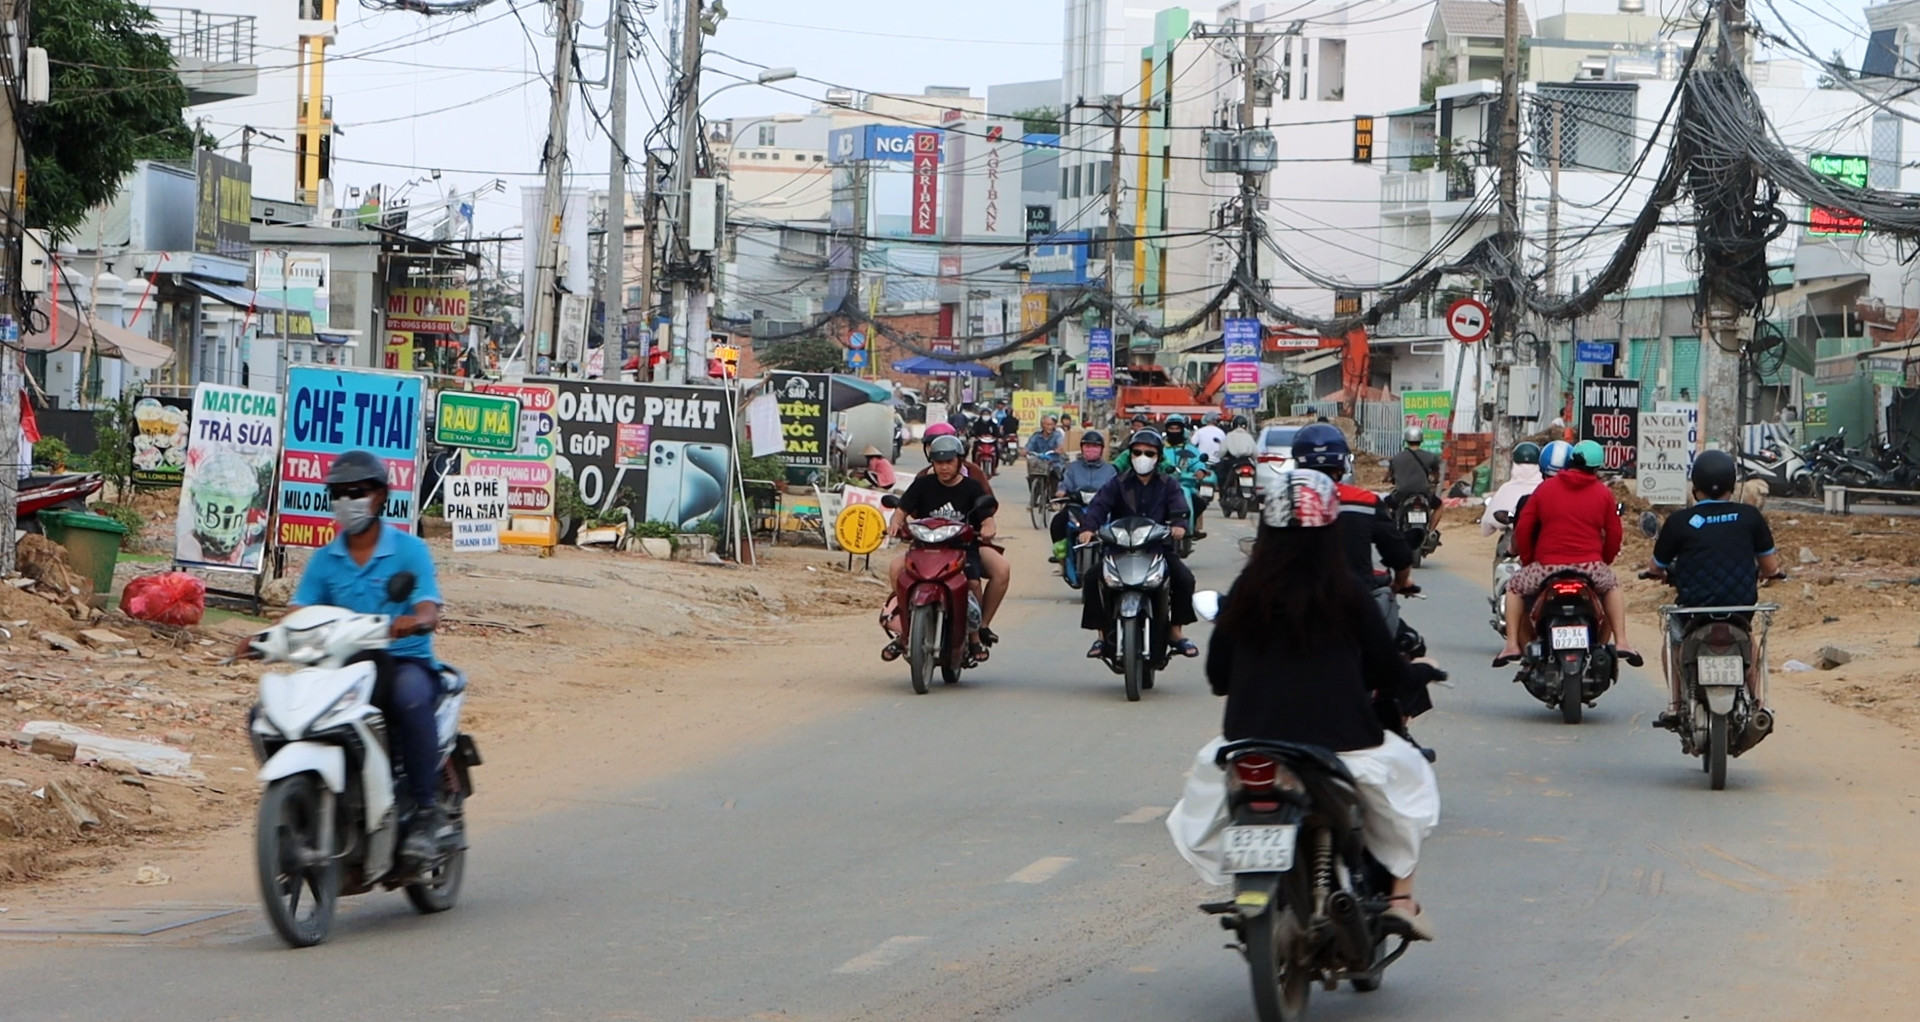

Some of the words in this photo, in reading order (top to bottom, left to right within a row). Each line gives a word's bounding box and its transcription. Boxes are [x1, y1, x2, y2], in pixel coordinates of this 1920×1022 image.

[876, 135, 914, 153] NGÂ
[919, 158, 932, 230] AGRIBANK
[986, 148, 999, 232] AGRIBANK
[202, 390, 276, 417] MATCHA
[534, 390, 552, 408] SỨ
[1602, 382, 1618, 408] TÓC
[1619, 387, 1638, 408] NAM
[293, 375, 346, 444] CHÈ
[354, 380, 414, 450] THÁI
[441, 404, 479, 432] RAU
[482, 402, 512, 436] MÁ
[558, 386, 636, 424] OÀNG
[643, 394, 721, 430] PHÁT
[778, 400, 820, 420] TIỆM
[199, 416, 232, 442] TRÀ
[782, 420, 814, 437] TÓC
[1592, 408, 1630, 438] TRÚC
[1642, 416, 1658, 426] AN
[1662, 416, 1684, 427] GIA
[570, 431, 610, 456] GÓP
[1643, 435, 1682, 452] Nệm
[287, 454, 322, 480] TRÀ
[388, 463, 412, 486] ÂY
[500, 465, 530, 480] PHONG
[530, 467, 548, 482] LAN
[1640, 462, 1684, 471] FUJIKA
[453, 478, 470, 496] CÀ
[474, 479, 499, 497] PHÊ
[284, 490, 310, 511] MILO
[447, 504, 473, 519] PHA
[477, 500, 504, 519] MÁY
[281, 523, 314, 545] SINH
[317, 520, 336, 546] TỐ
[455, 536, 480, 546] CHANH
